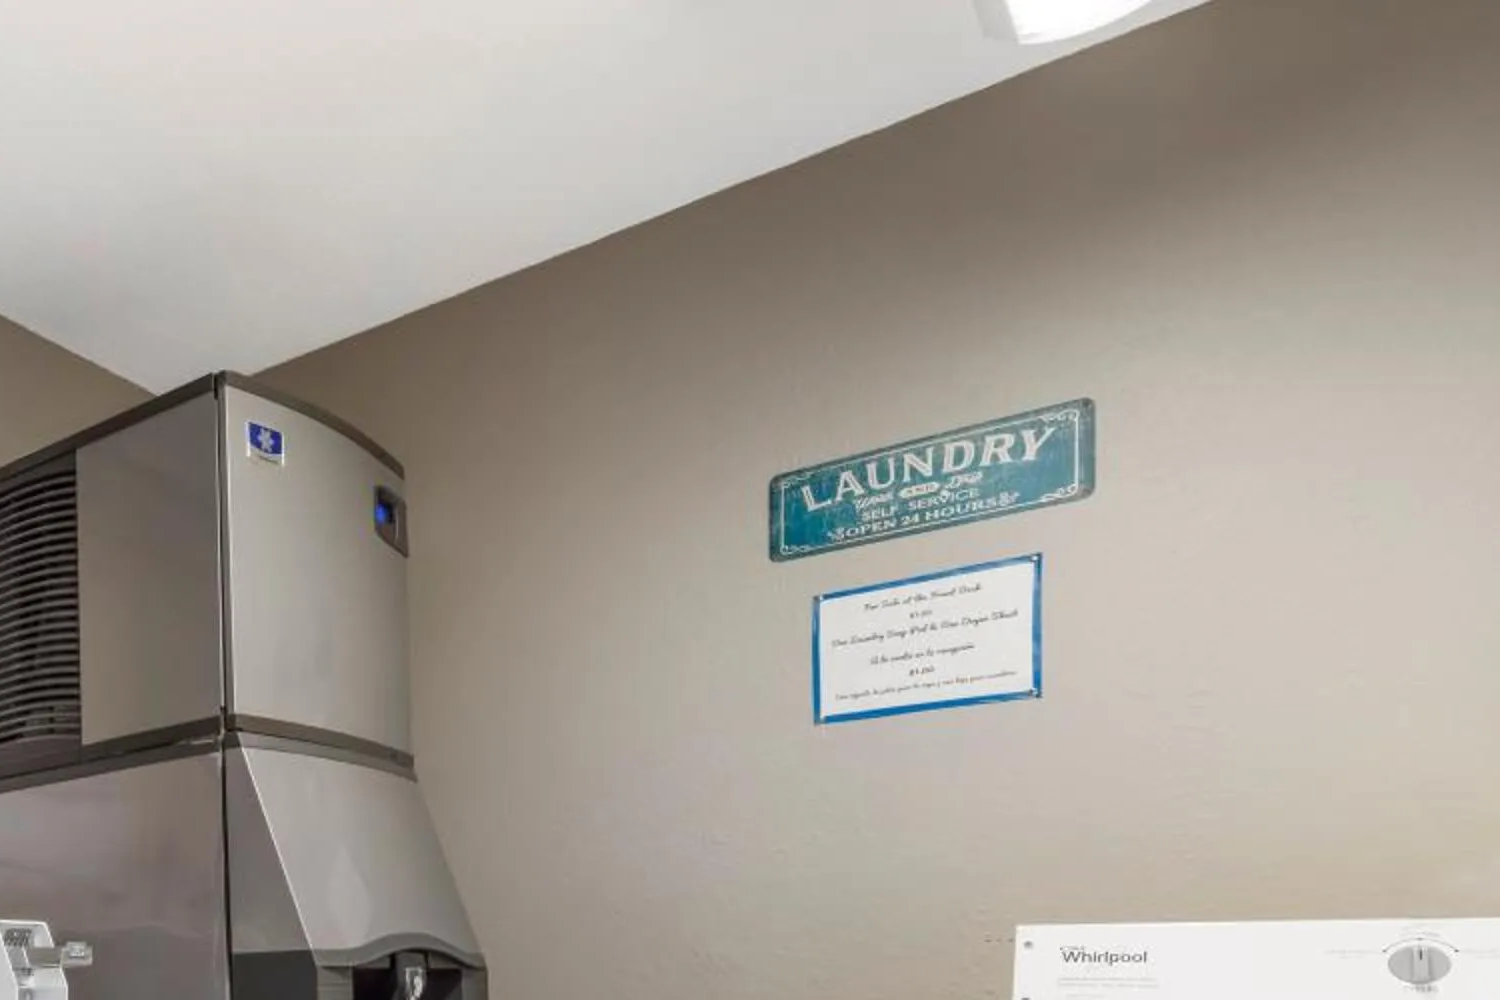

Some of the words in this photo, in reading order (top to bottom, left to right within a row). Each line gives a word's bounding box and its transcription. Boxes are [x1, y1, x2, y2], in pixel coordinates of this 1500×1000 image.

[802, 427, 1056, 512] LAUNDRY
[843, 516, 897, 538] OPEN
[901, 511, 920, 525] 24
[925, 496, 998, 521] HOURS
[862, 506, 898, 522] SELF
[908, 487, 980, 510] SERVICE
[1062, 950, 1148, 967] Whirlpool
